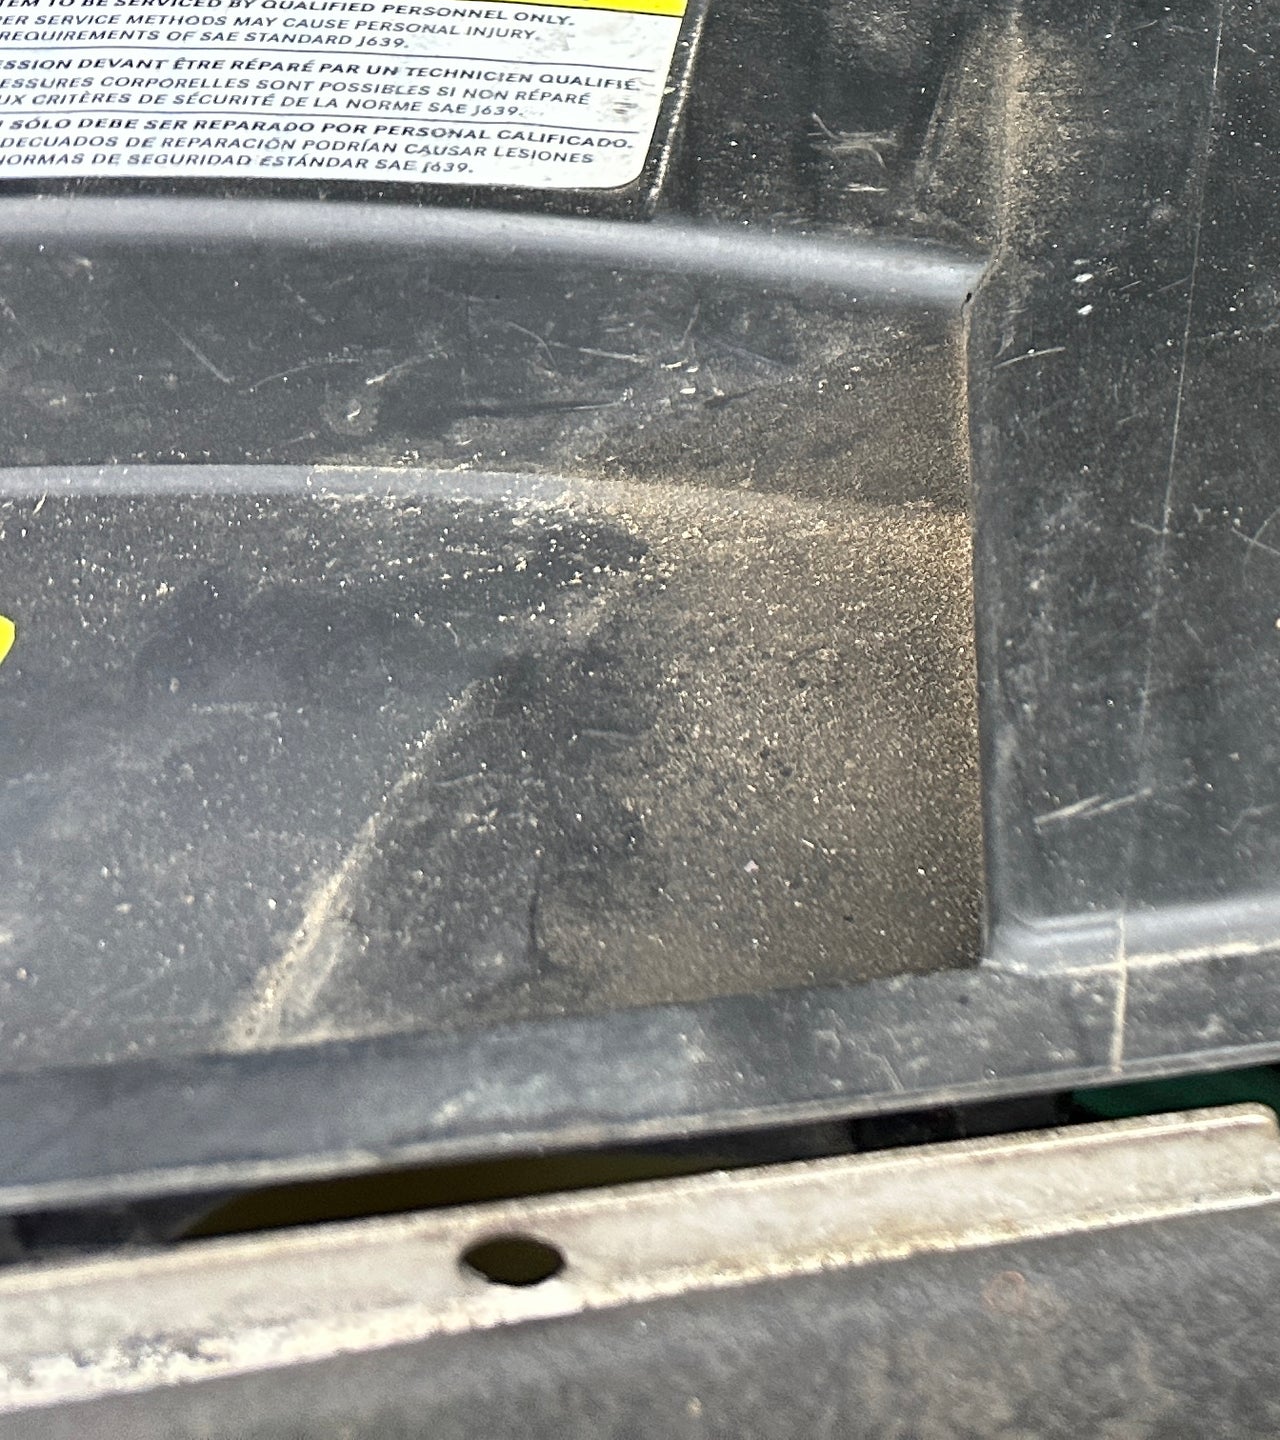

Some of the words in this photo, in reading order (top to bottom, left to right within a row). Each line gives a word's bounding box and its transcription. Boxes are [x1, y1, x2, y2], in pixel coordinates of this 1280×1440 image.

[260, 0, 376, 13] QUALIFIED
[381, 3, 509, 20] PERSONNEL
[513, 11, 576, 26] ONLY.
[0, 30, 161, 42] REQUIREMENTS
[166, 30, 197, 42] OF
[200, 31, 241, 42] SAE
[243, 32, 353, 45] STANDARD
[355, 35, 410, 49] J639.
[34, 14, 121, 26] SERVICE
[125, 14, 228, 26] METHODS
[232, 16, 278, 28] MAY
[282, 17, 350, 31] CAUSE
[354, 20, 461, 36] PERSONAL
[466, 26, 542, 41] INJURY.
[77, 58, 170, 70] DEVANT
[172, 56, 224, 70] ÊTRE
[229, 57, 317, 73] RÉPARÉ
[318, 63, 362, 74] PAR
[366, 65, 399, 76] UN
[405, 67, 535, 84] TECHNICIEN
[32, 90, 132, 106] CRITÈRES
[137, 93, 169, 105] DE
[172, 91, 276, 107] SÉCURITÉ
[280, 96, 310, 108] DE
[313, 97, 339, 109] LA
[345, 98, 424, 112] NORME
[427, 102, 469, 115] SAE
[470, 105, 524, 118] J639.
[100, 76, 251, 90] CORPORELLES
[255, 79, 315, 91] SONT
[318, 81, 431, 96] POSSIBLES
[436, 86, 456, 97] SI
[462, 88, 510, 101] NON
[513, 88, 593, 106] RÉPARÉ
[9, 116, 72, 130] SÓLO
[77, 118, 140, 130] DEBE
[143, 119, 188, 131] SER
[192, 119, 315, 133] REPARADO
[320, 122, 368, 135] POR
[372, 125, 492, 140] PERSONAL
[496, 130, 634, 149] CALIFICADO.
[125, 136, 157, 149] DE
[161, 135, 297, 151] REPARACIÓN
[301, 138, 399, 155] PODRÍAN
[403, 142, 487, 158] CAUSAR
[493, 146, 594, 164] LESIONES
[91, 154, 122, 166] DE
[127, 154, 252, 167] SEGURIDAD
[258, 153, 369, 170] ESTÁNDAR
[374, 159, 419, 172] SAE
[421, 162, 474, 175] J639.
